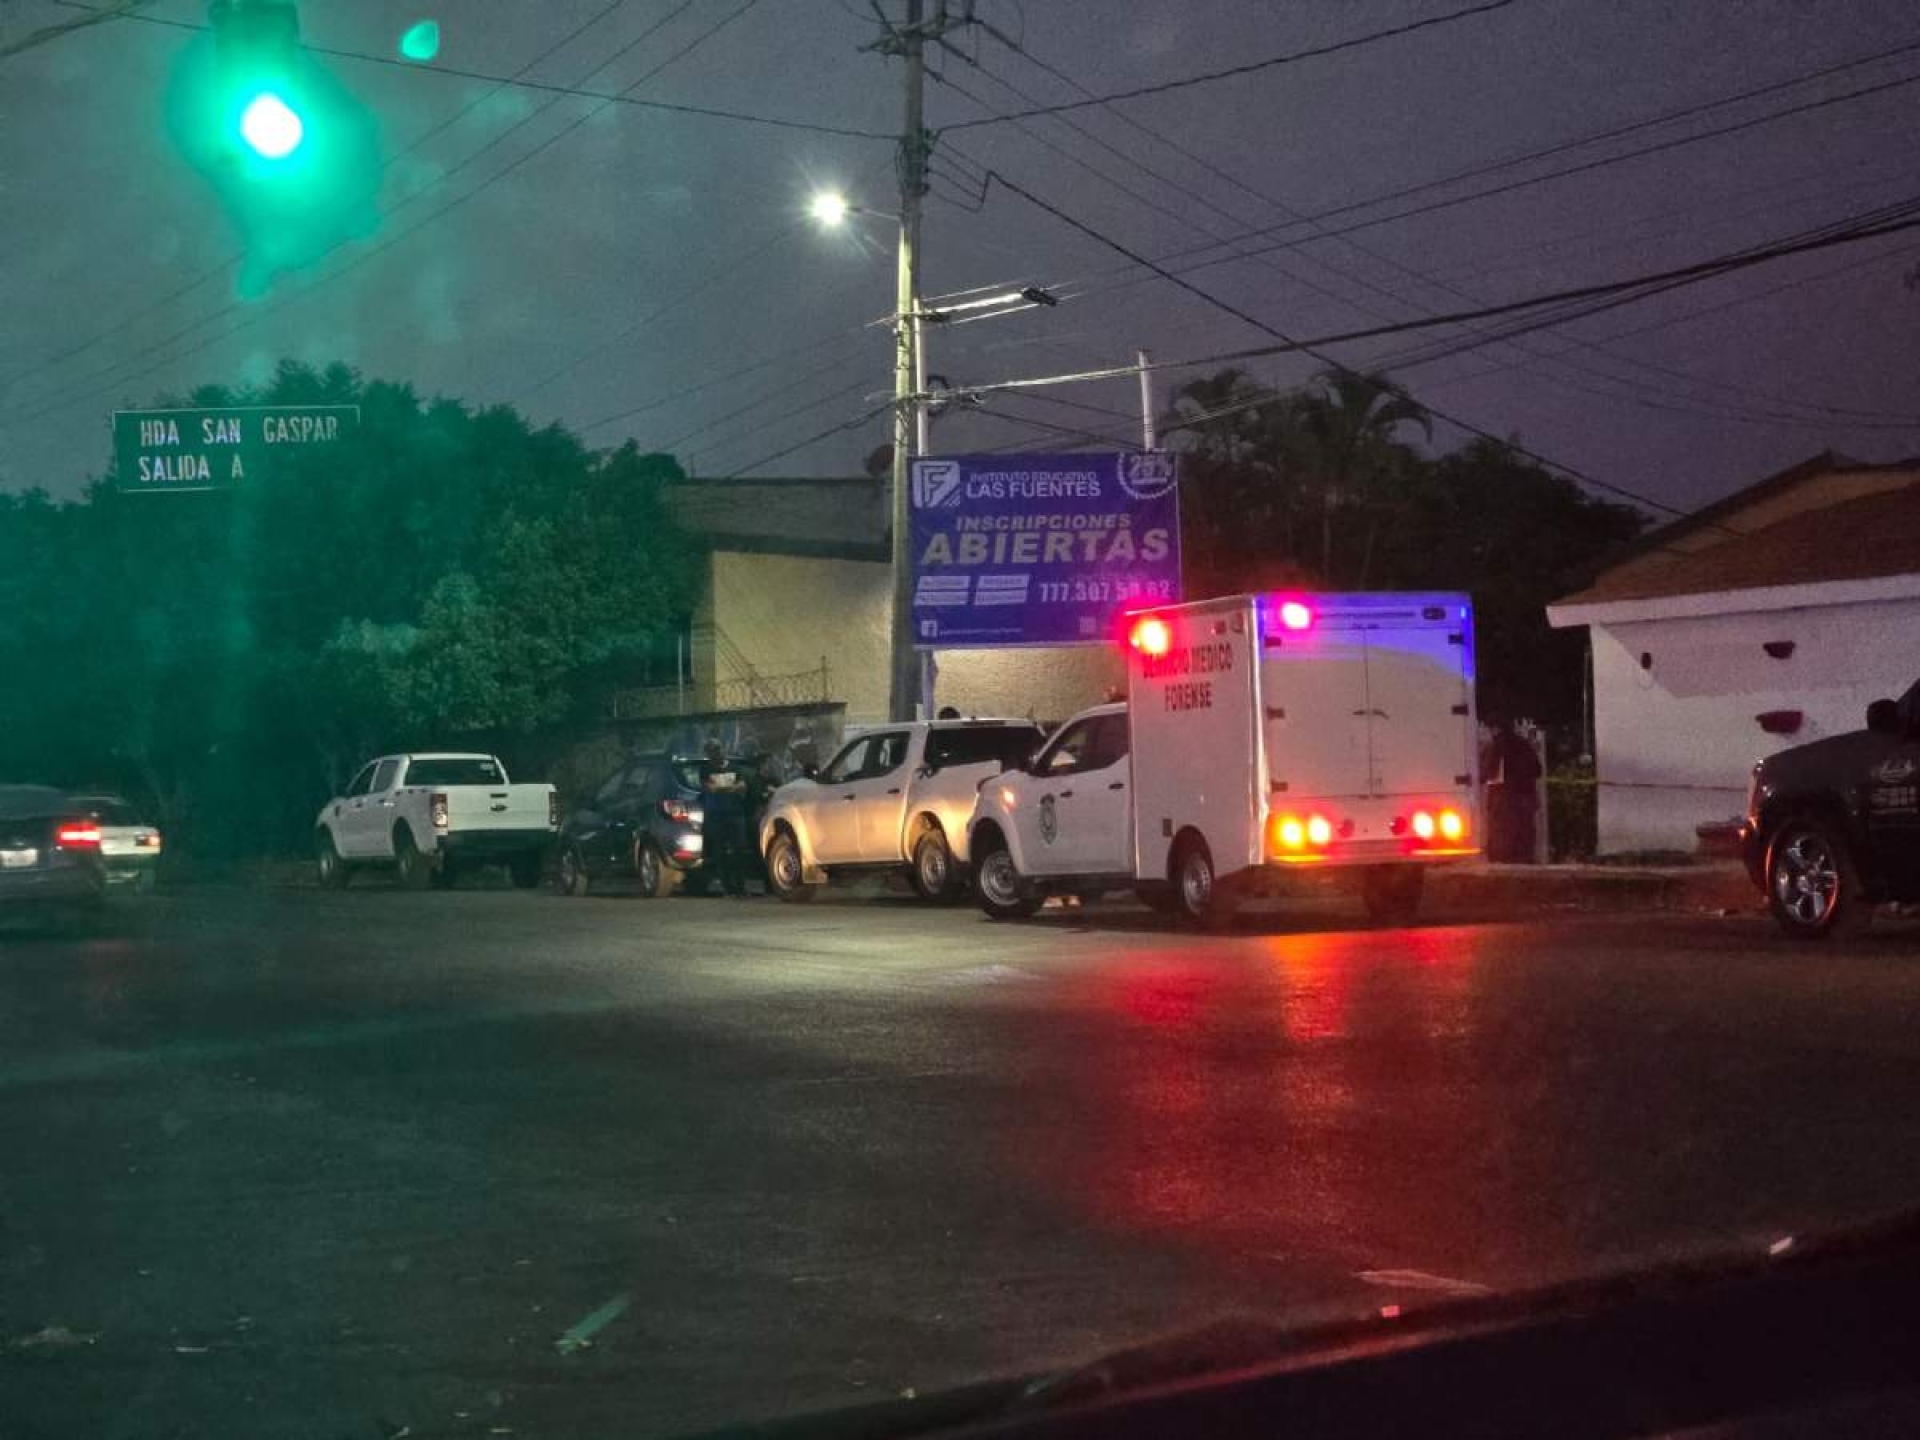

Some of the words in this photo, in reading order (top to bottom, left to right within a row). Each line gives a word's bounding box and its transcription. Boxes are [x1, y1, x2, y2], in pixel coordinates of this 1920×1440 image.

[140, 419, 180, 447] HDA
[202, 417, 241, 444] SAN
[263, 415, 338, 443] GASPAR
[138, 455, 211, 482] SALIDA
[231, 454, 244, 478] A
[966, 481, 1005, 499] LAS
[1008, 480, 1102, 499] FUENTES
[956, 513, 1131, 532] INSCRIPCIONES
[921, 528, 1169, 565] ABIERTAS
[1164, 682, 1212, 712] FORENSE
